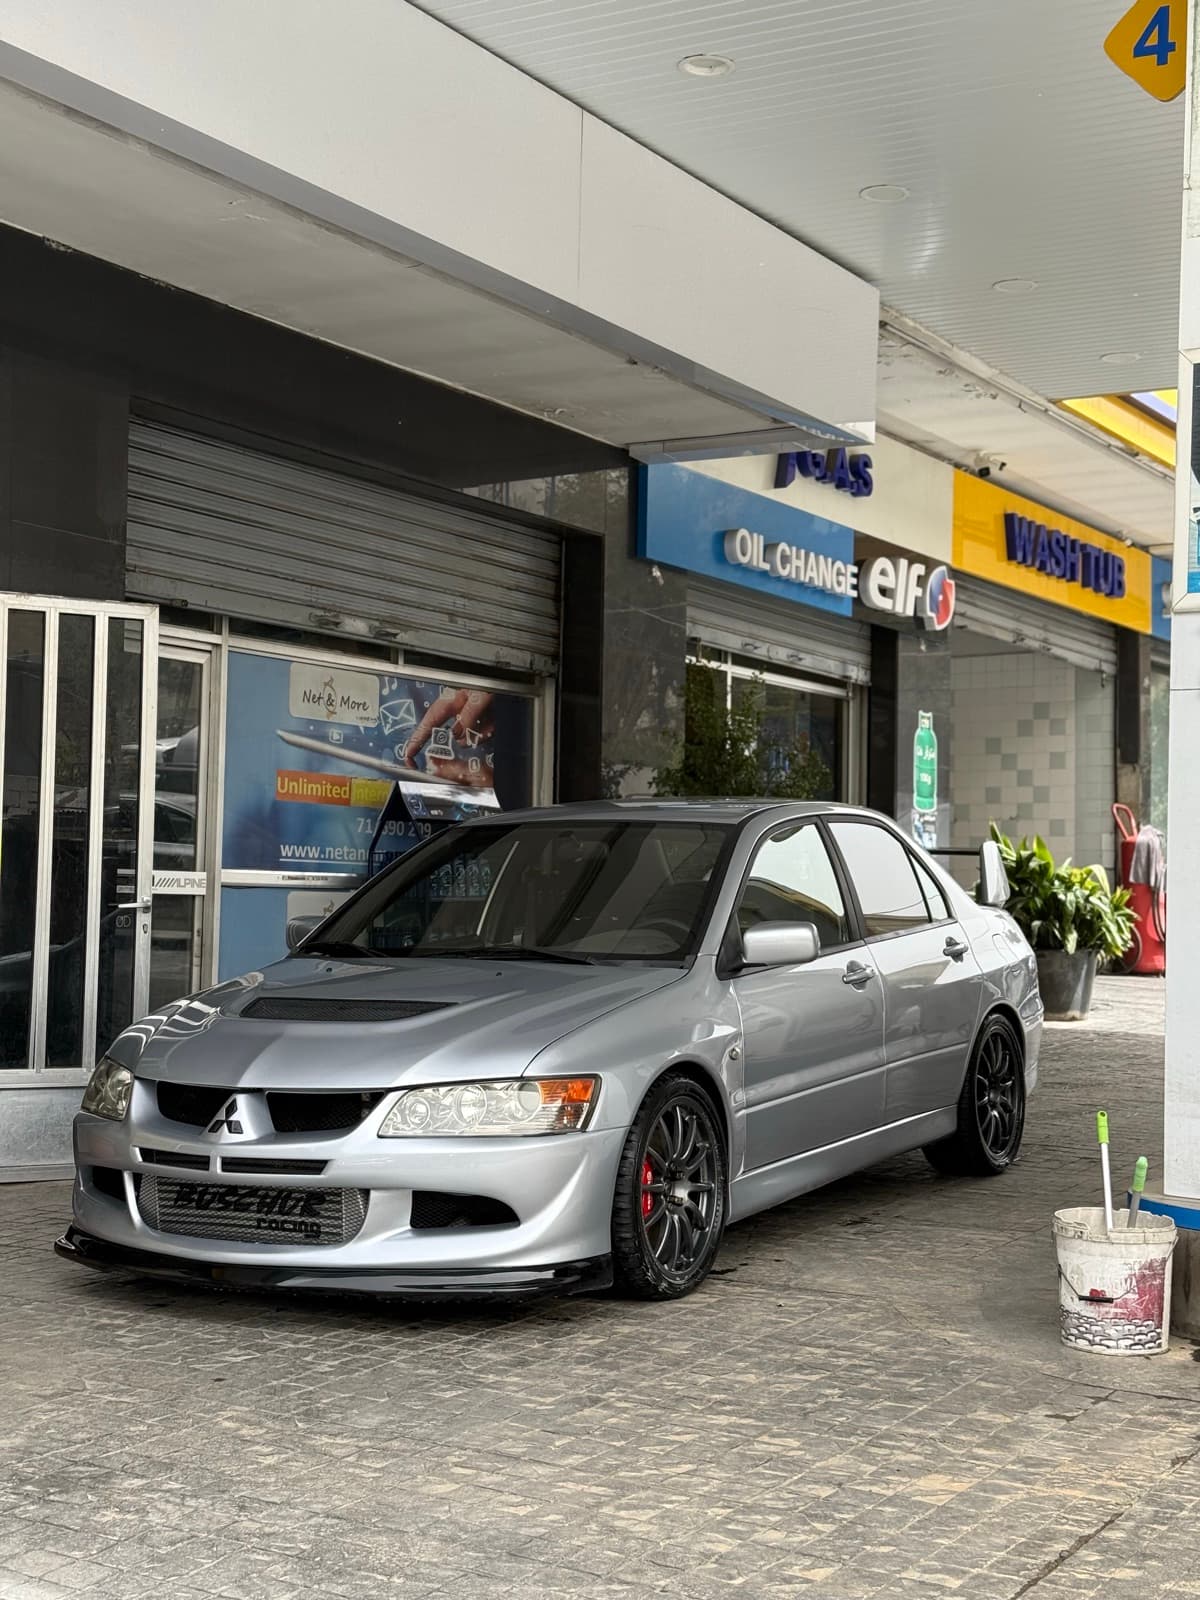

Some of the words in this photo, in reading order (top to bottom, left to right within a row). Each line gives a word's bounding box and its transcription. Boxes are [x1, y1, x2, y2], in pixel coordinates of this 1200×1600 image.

[1133, 5, 1176, 66] 4
[727, 528, 770, 571] OIL
[772, 542, 858, 597] CHANGE
[1005, 513, 1078, 582] WASH
[1081, 544, 1125, 598] TUB
[866, 557, 925, 616] elf
[302, 689, 324, 705] Net
[326, 693, 335, 707] &
[340, 695, 370, 711] More
[277, 776, 350, 799] Unlimited
